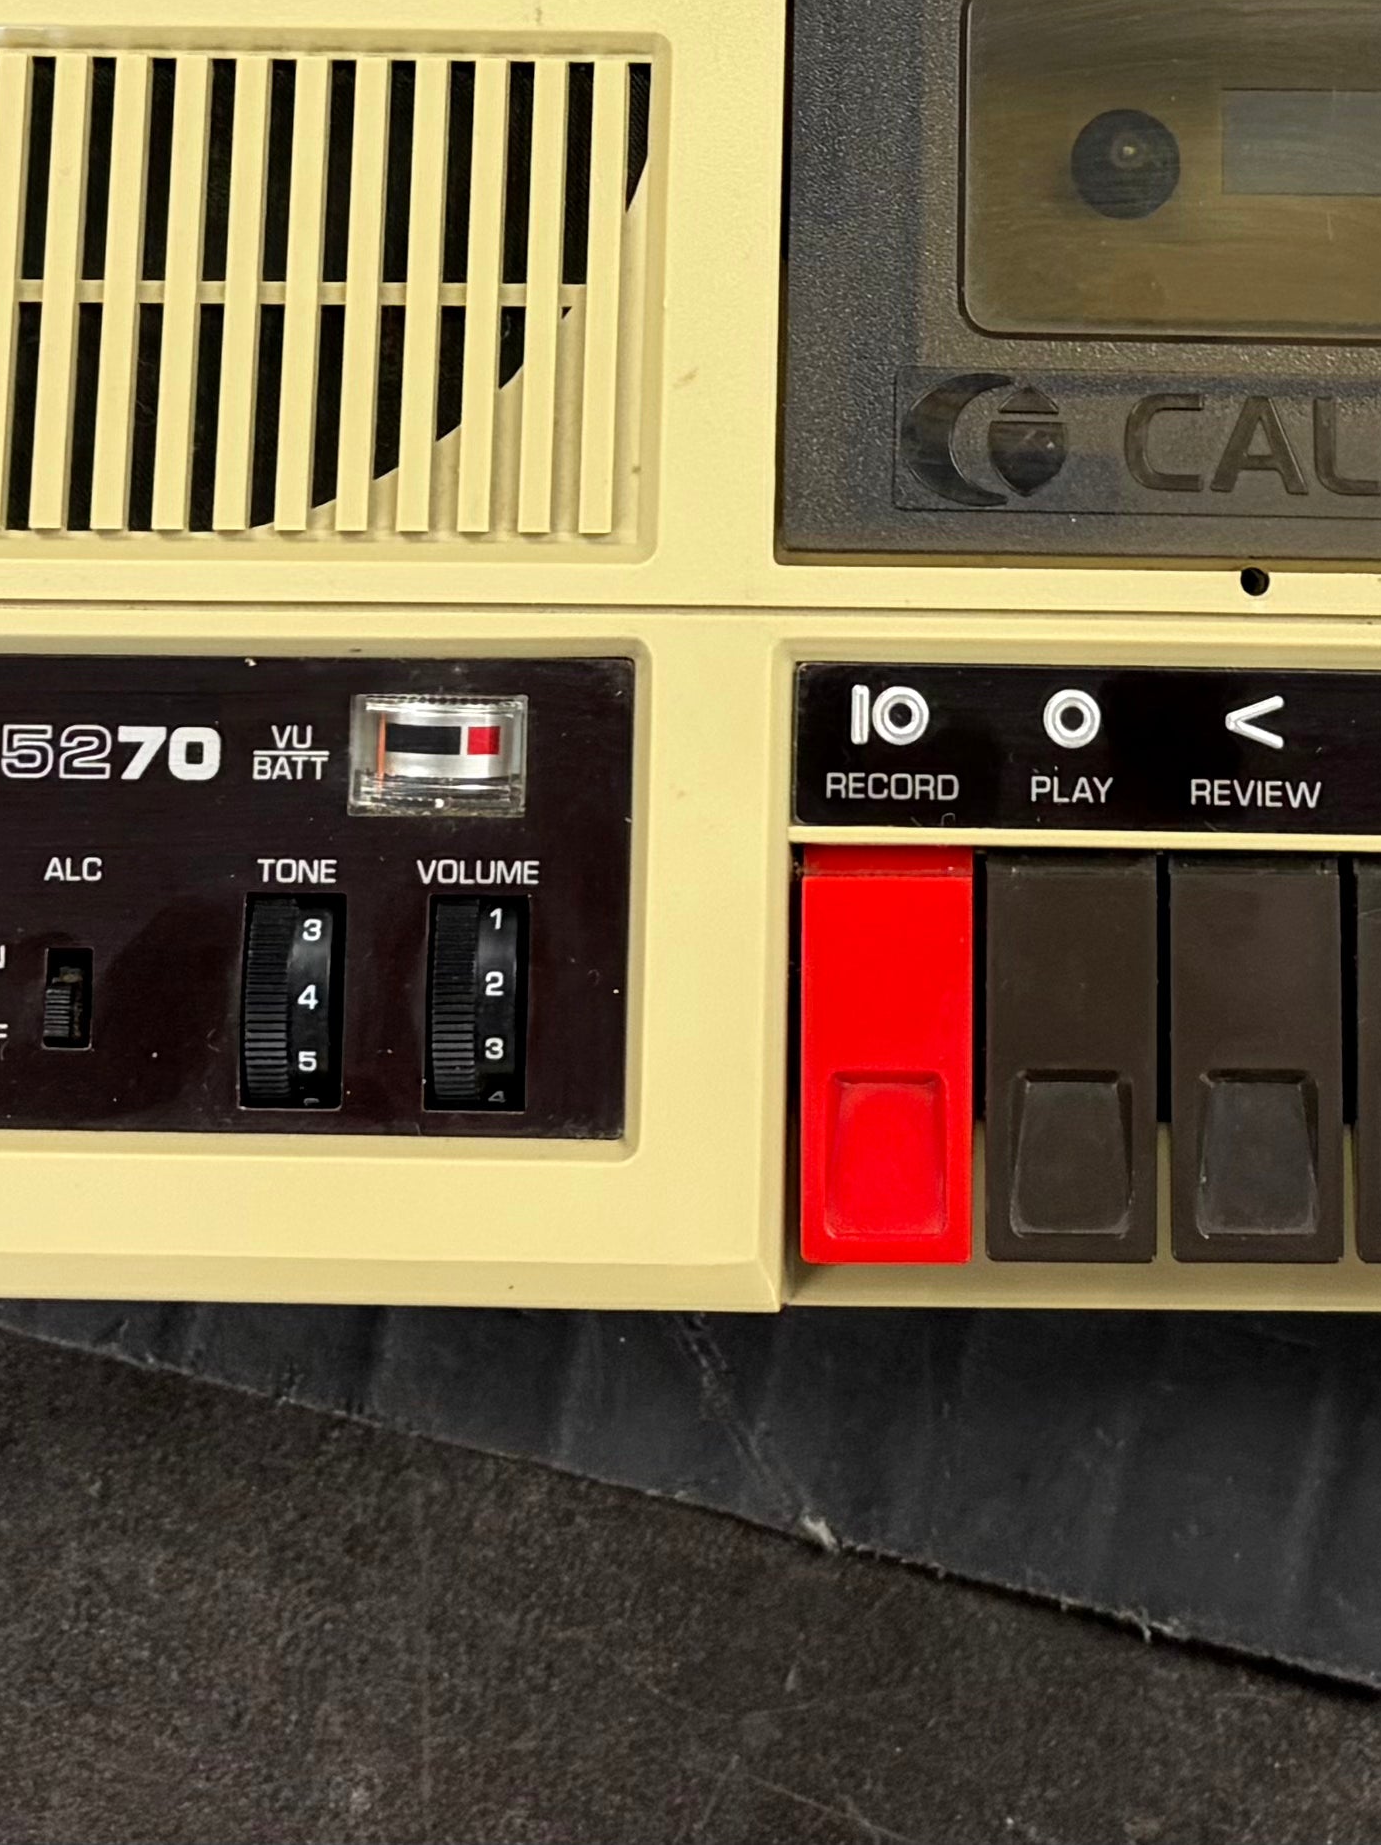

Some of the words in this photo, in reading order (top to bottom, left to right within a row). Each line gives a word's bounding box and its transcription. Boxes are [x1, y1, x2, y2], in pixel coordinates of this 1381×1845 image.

[270, 724, 313, 749] VU
[0, 724, 221, 781] 5270
[251, 754, 329, 781] BATT
[826, 772, 959, 800] RECORD
[1031, 775, 1113, 803] PLAY
[1190, 779, 1322, 809] REVIEW
[43, 856, 103, 882] ALC
[256, 858, 338, 884] TONE
[416, 859, 540, 885] VOLUME
[302, 918, 323, 942] 3
[489, 907, 502, 930] 1
[485, 970, 504, 997] 2
[297, 984, 319, 1010] 4
[298, 1050, 317, 1072] 5
[485, 1037, 504, 1060] 3
